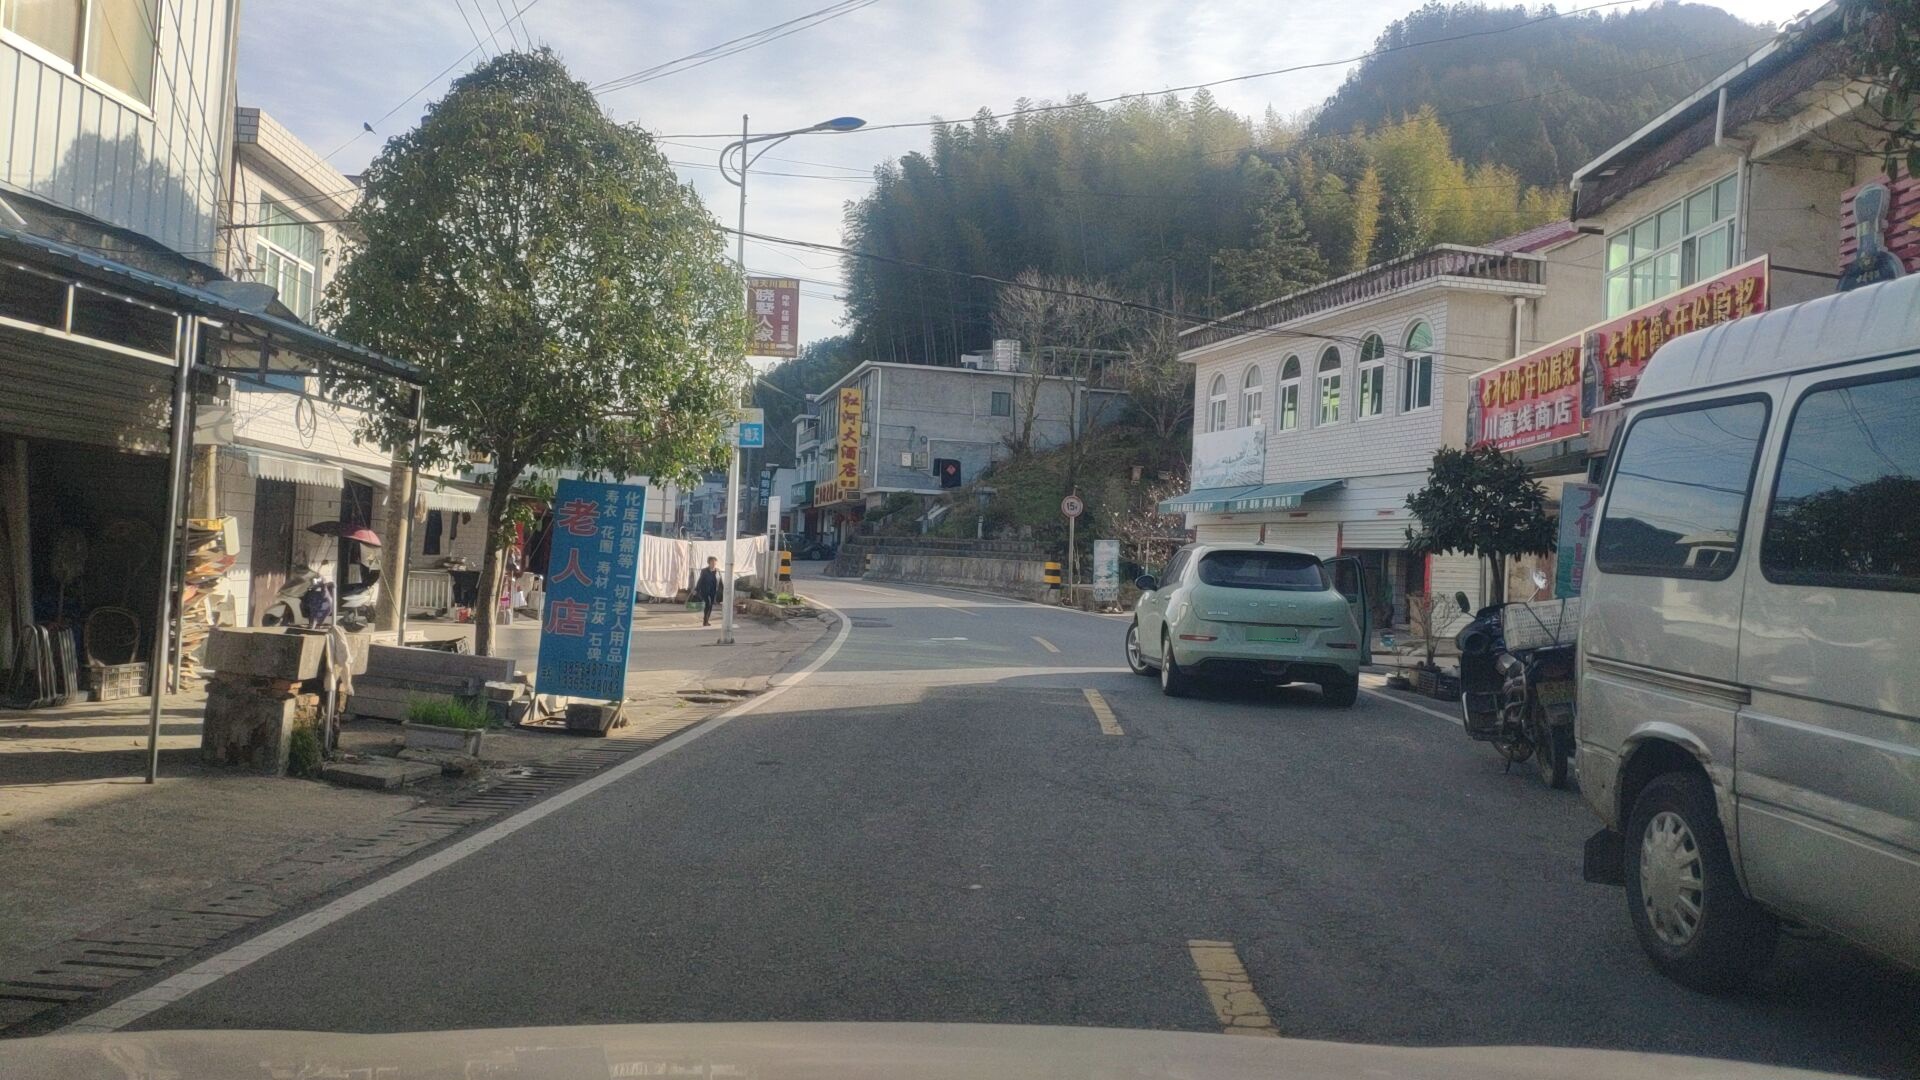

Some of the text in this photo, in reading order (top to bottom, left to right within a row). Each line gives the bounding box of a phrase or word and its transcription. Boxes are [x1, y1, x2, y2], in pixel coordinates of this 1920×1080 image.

[1482, 395, 1573, 441] 川藏线商店
[839, 391, 860, 478] 红河大酒店
[603, 489, 620, 519] 寿衣
[545, 498, 600, 637] 老人店
[595, 561, 611, 590] 寿材
[591, 597, 608, 626] 石灰
[586, 632, 604, 662] 石碑
